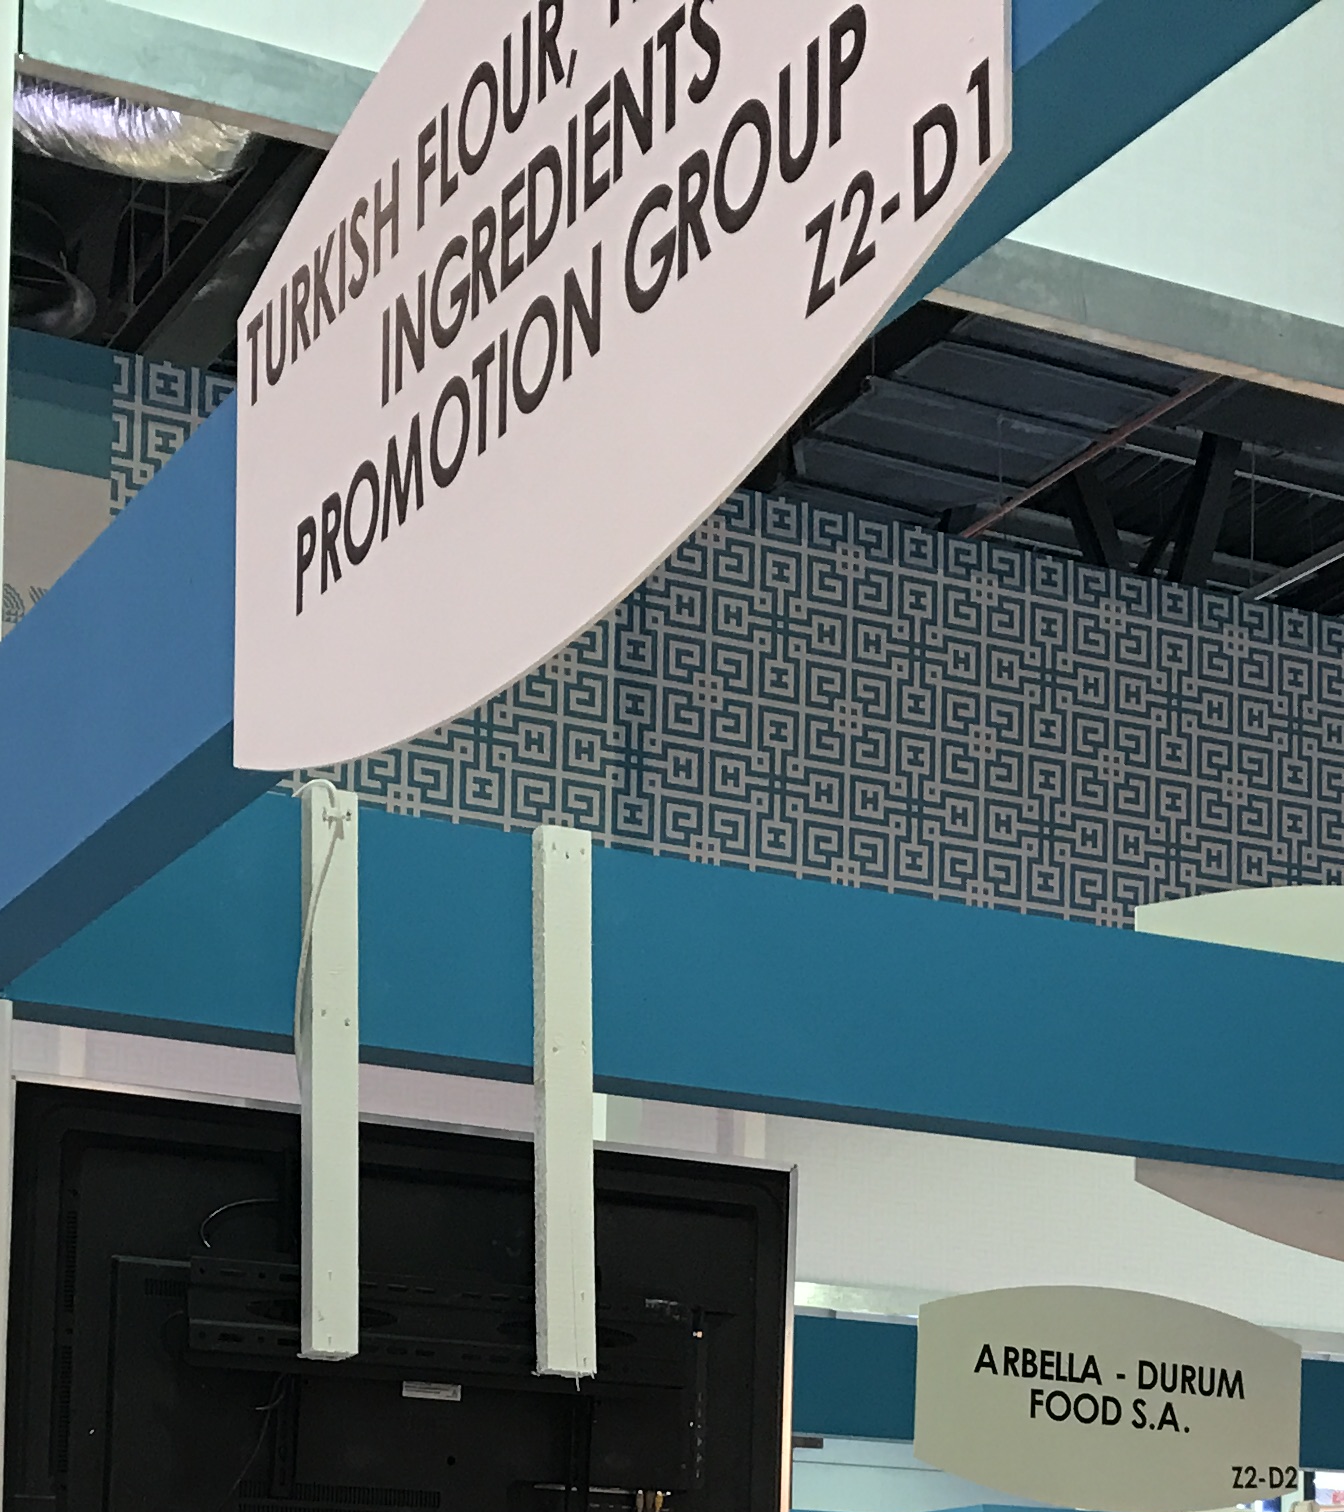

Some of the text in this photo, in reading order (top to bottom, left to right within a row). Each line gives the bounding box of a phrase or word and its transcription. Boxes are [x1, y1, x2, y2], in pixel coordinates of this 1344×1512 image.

[246, 0, 578, 407] TURKISH FLOUR,
[295, 6, 868, 617] PROMOTION GROUP
[382, 0, 721, 407] INGREDIENTS
[974, 1343, 1103, 1386] ARBELLA
[1138, 1360, 1246, 1400] DURUM
[1029, 1388, 1191, 1434] FOOD S.A.
[1231, 1465, 1299, 1490] Z2-D2
